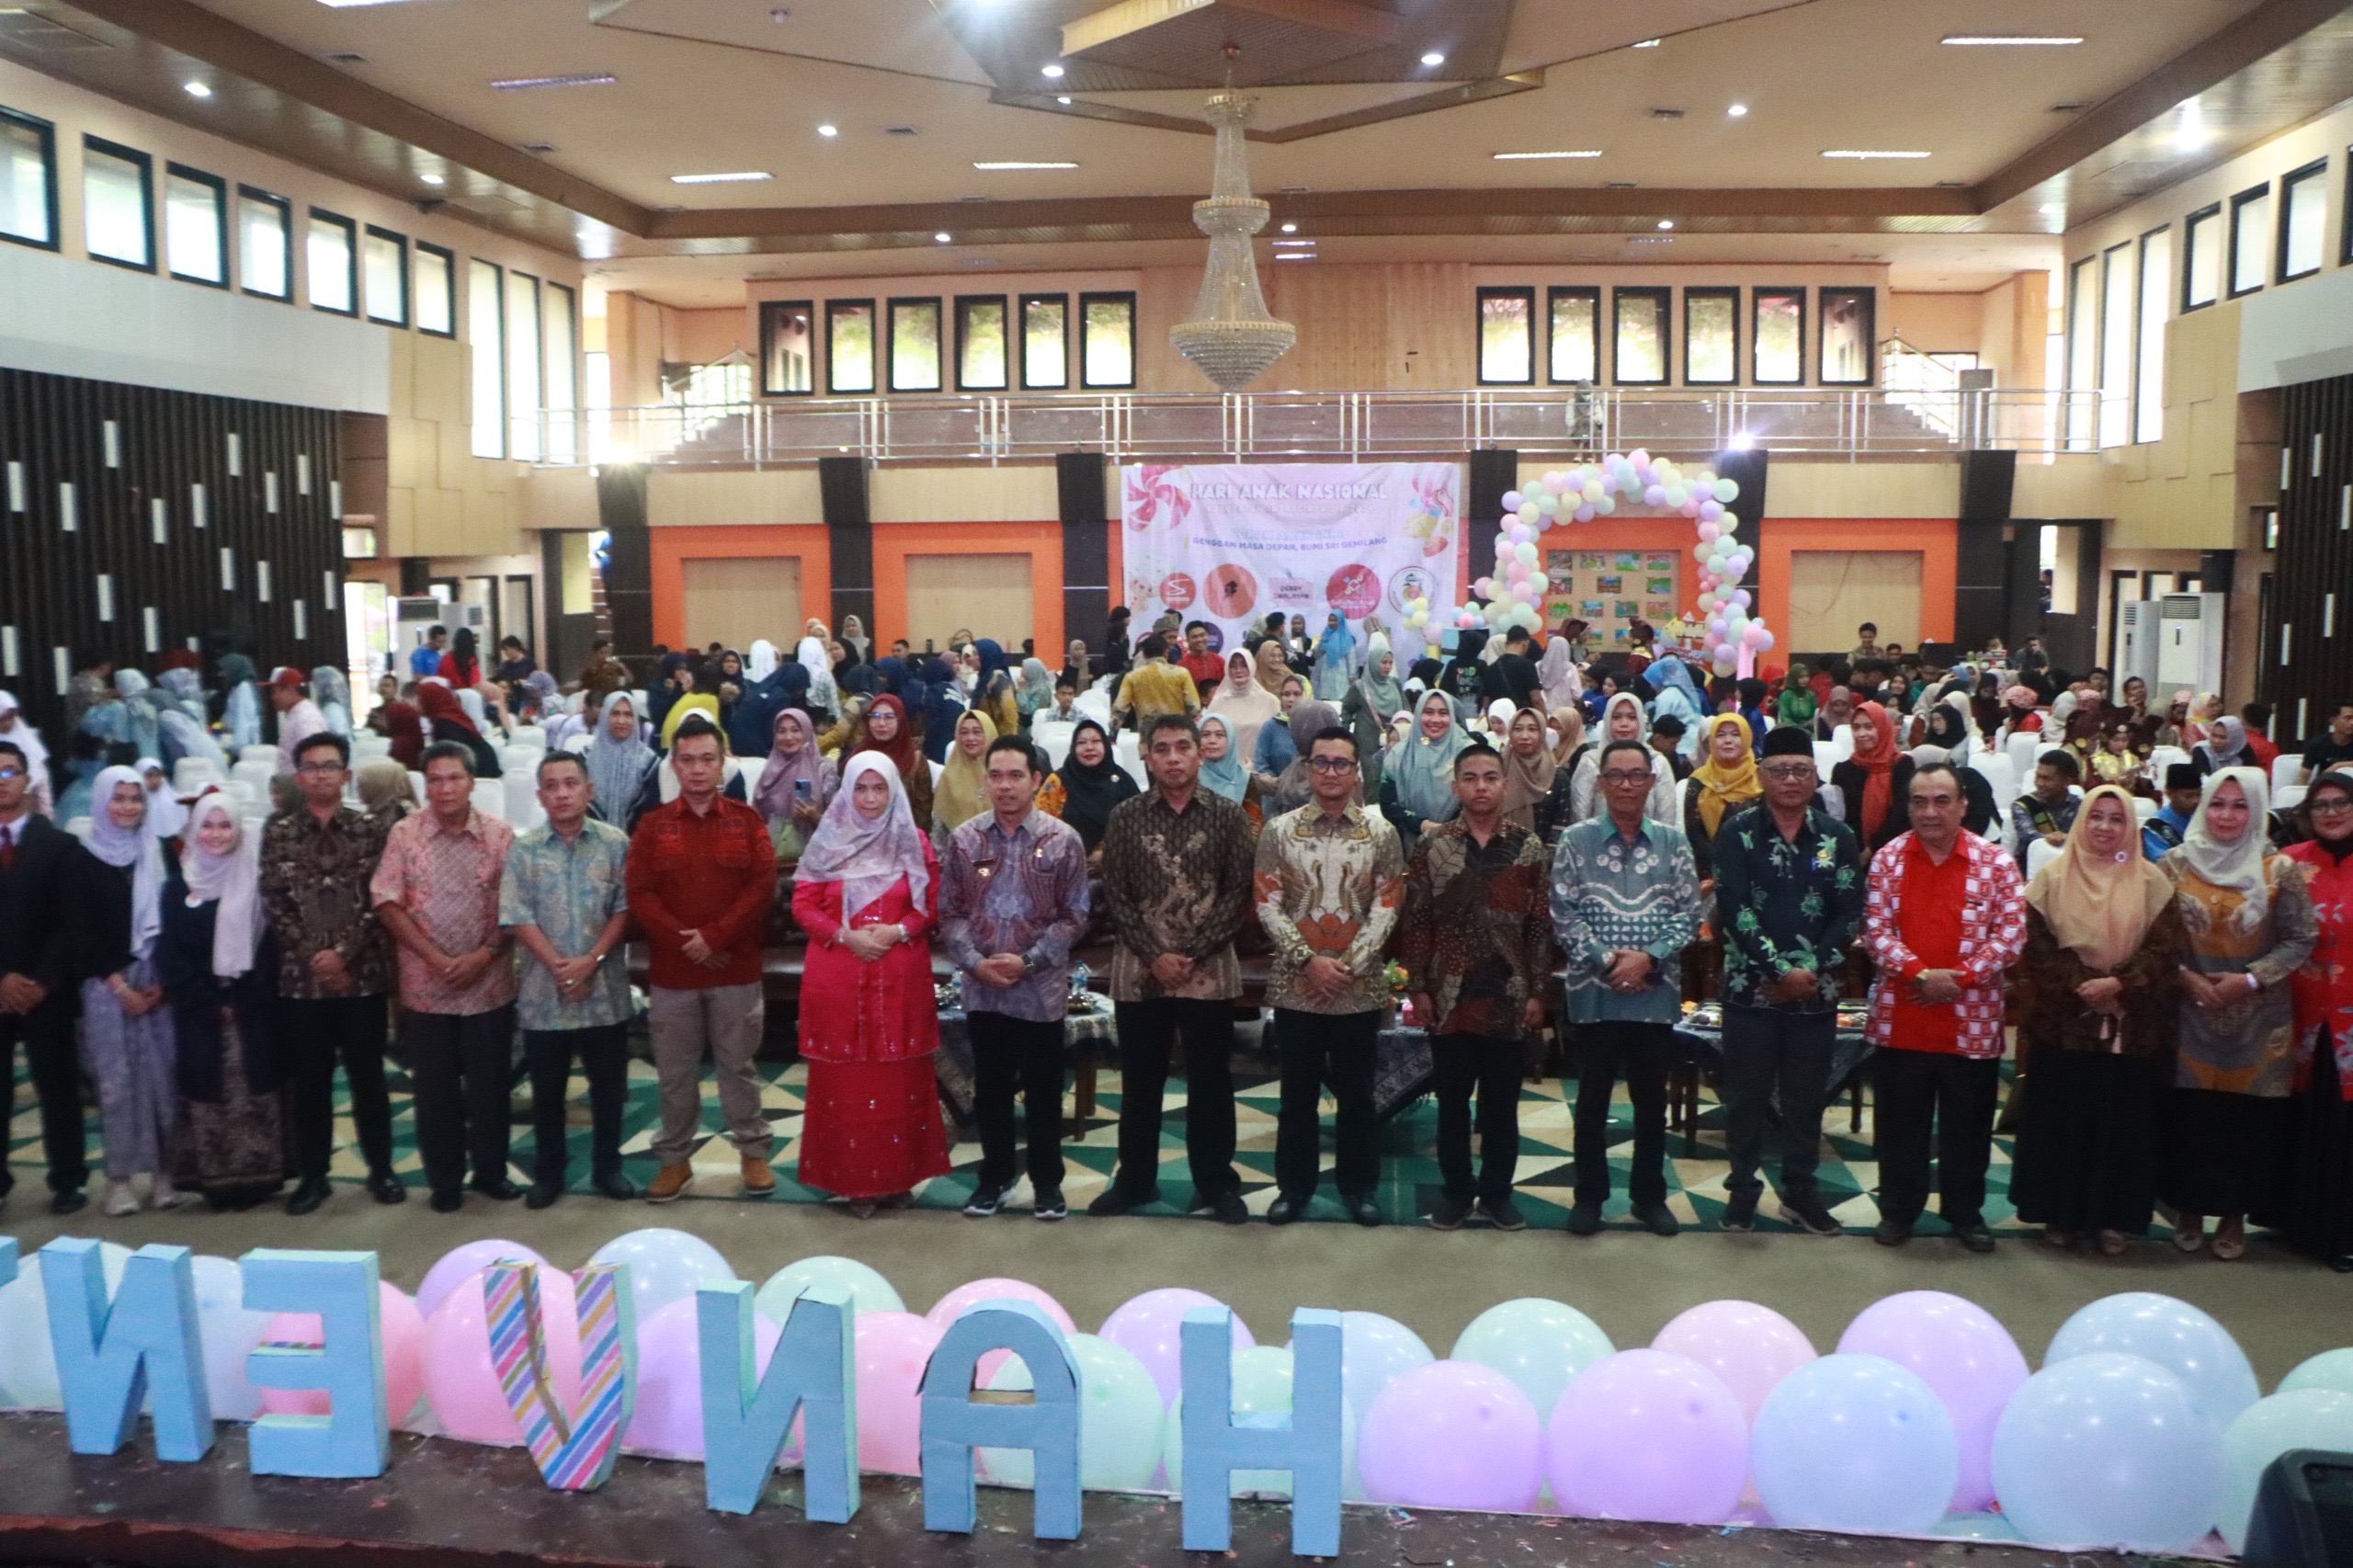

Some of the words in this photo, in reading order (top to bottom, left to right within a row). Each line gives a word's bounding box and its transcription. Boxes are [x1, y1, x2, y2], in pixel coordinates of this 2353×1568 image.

[1190, 483, 1232, 500] HARI
[1238, 483, 1290, 500] ANAK
[1296, 483, 1389, 500] NASIONAL
[1192, 537, 1237, 549] GENGGAM
[1239, 542, 1264, 551] MASA
[1341, 537, 1388, 549] GEMILANG
